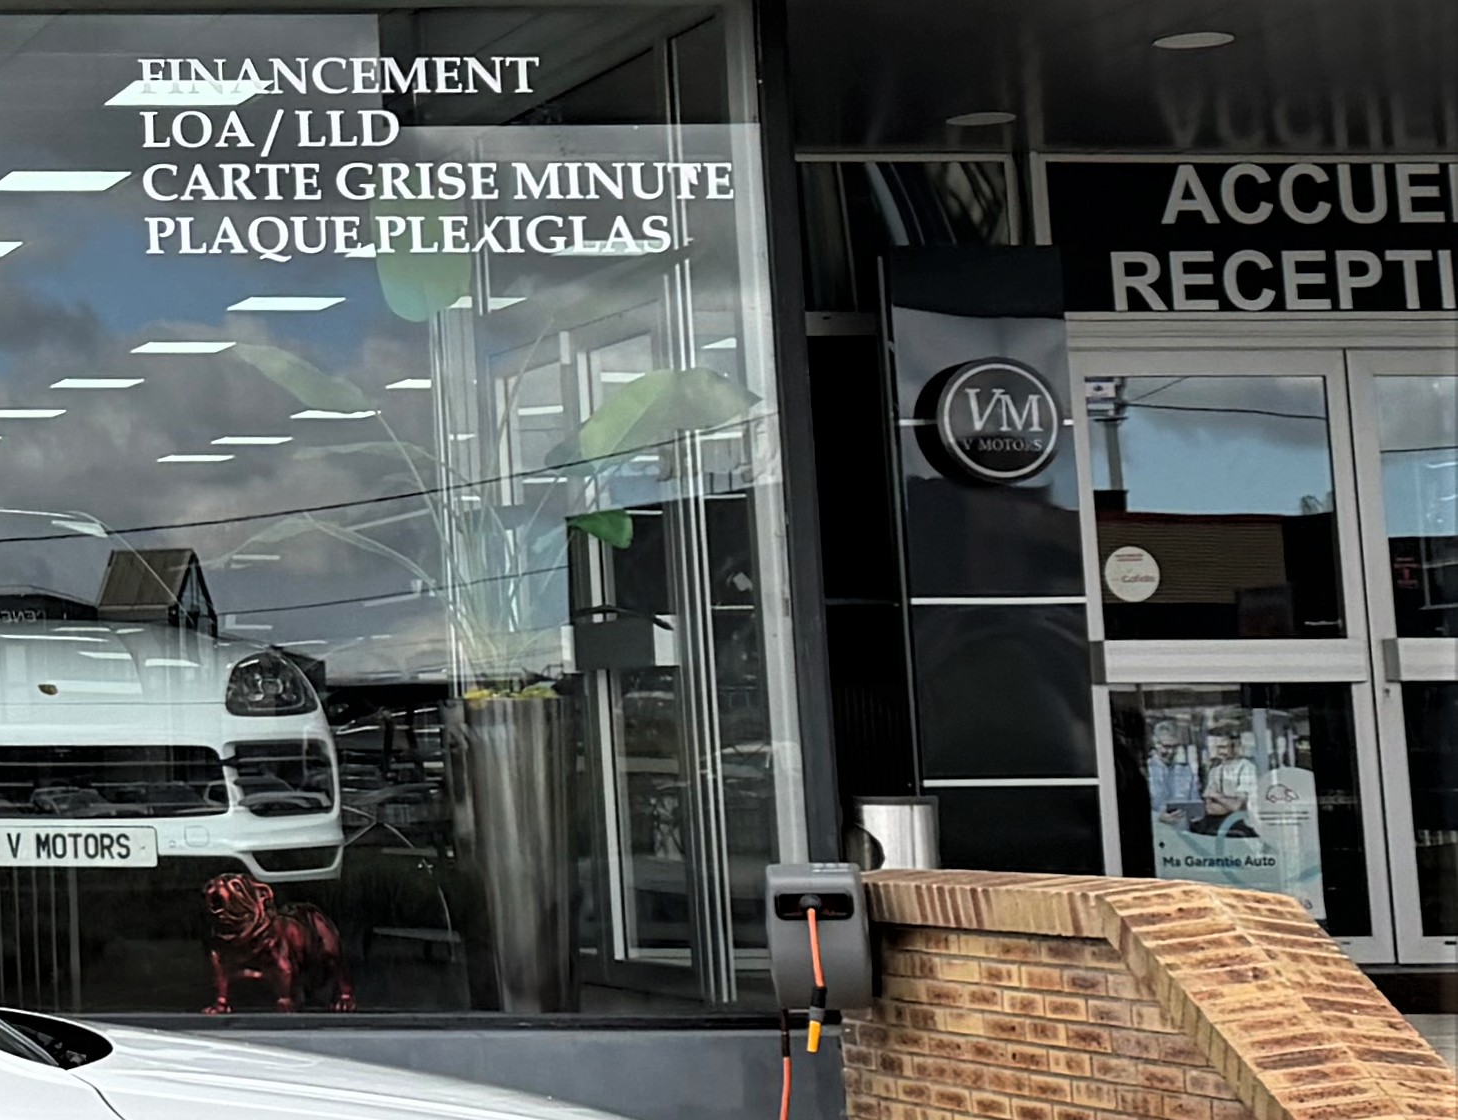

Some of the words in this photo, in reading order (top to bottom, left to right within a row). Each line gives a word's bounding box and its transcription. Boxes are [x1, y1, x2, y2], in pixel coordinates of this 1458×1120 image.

[137, 56, 540, 95] FINANCEMENT
[142, 163, 323, 202] CARTE
[335, 163, 501, 202] GRISE
[512, 162, 735, 201] MINUTE
[145, 215, 363, 263] PLAQUE
[376, 215, 673, 255] PLEXIGLAS
[1110, 249, 1458, 311] RECEPTI
[965, 388, 1044, 432] VM
[6, 832, 21, 859] V
[34, 832, 131, 860] MOTORS
[1162, 856, 1182, 867] Ma
[1184, 855, 1242, 868] Garantie
[1244, 854, 1276, 867] Auto
